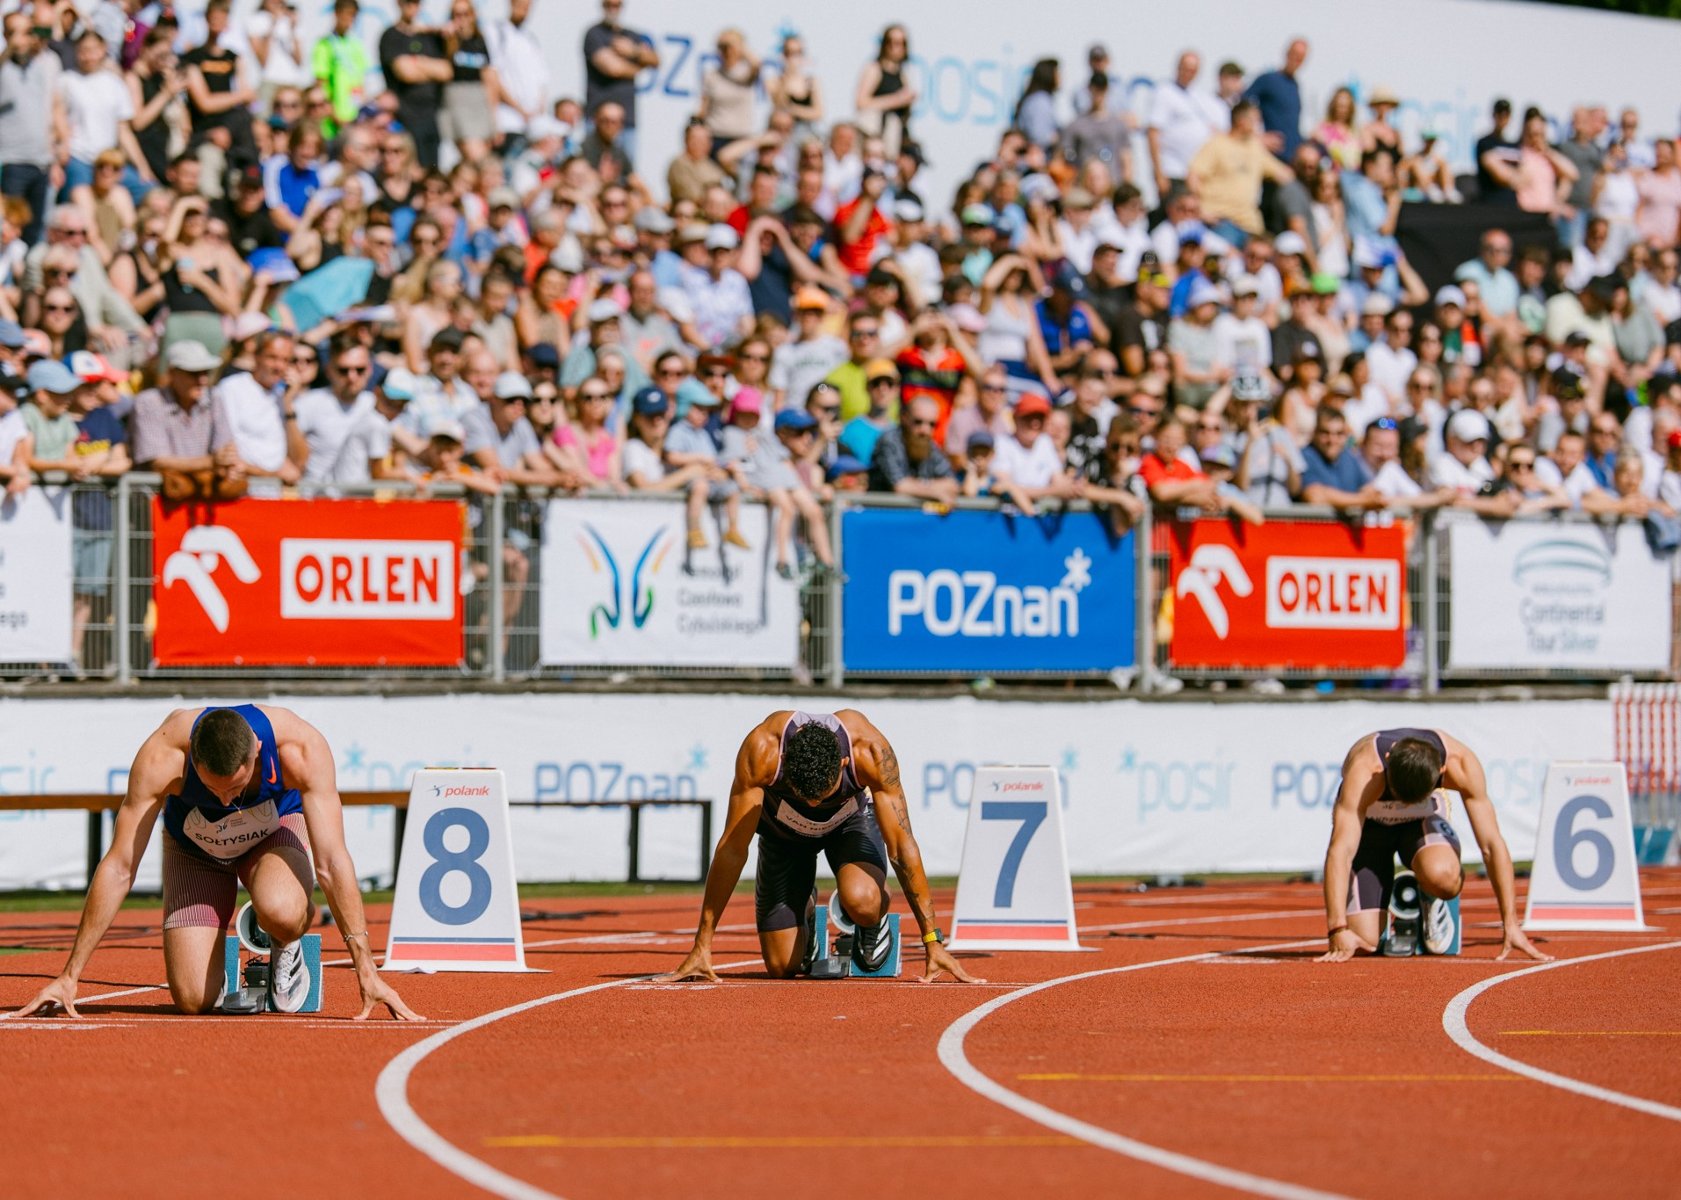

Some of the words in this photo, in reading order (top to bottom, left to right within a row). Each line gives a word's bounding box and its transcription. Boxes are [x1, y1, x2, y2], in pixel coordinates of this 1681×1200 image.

[295, 554, 438, 603] ORLEN
[1279, 572, 1387, 613] ORLEN
[445, 785, 490, 799] polanik
[1003, 781, 1044, 793] polanik
[194, 828, 269, 846] SOŁTYSIAK
[981, 801, 1047, 908] 7
[1553, 795, 1616, 890] 6
[419, 807, 492, 926] 8
